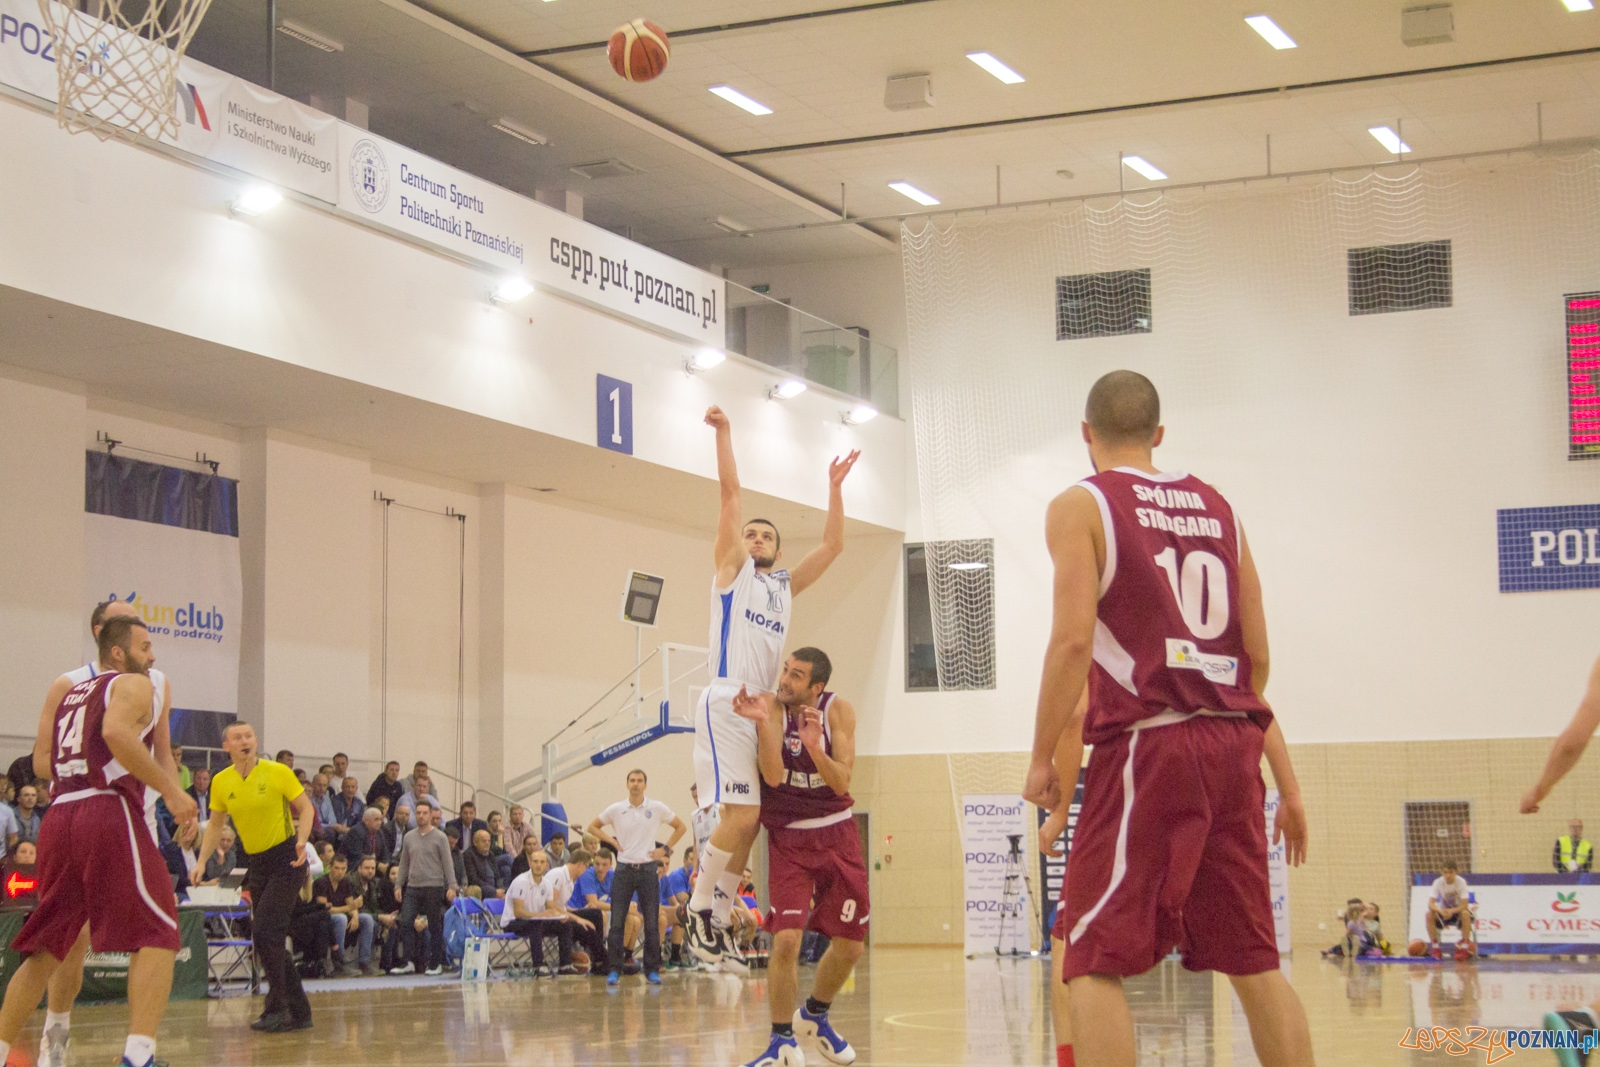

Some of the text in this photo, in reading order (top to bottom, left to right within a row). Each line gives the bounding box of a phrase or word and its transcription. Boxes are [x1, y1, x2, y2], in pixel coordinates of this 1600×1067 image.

[228, 101, 316, 146] Ministerstwo Nauki
[228, 121, 332, 173] i Szkolnictwa Wyższego
[400, 163, 447, 199] Centrum
[450, 183, 484, 214] Sportu
[400, 195, 524, 264] Politechniki Poznańskiej
[550, 237, 717, 329] cspp.put.poznan.pl
[609, 387, 622, 445] 1
[1132, 484, 1206, 511] SPÓJNIA
[1154, 546, 1229, 640] 10
[147, 626, 223, 643] uro podróży
[57, 705, 87, 760] 14
[602, 729, 653, 758] PESMENPOL
[732, 783, 750, 794] PBG
[840, 899, 857, 923] 9
[1527, 918, 1600, 931] CYMES
